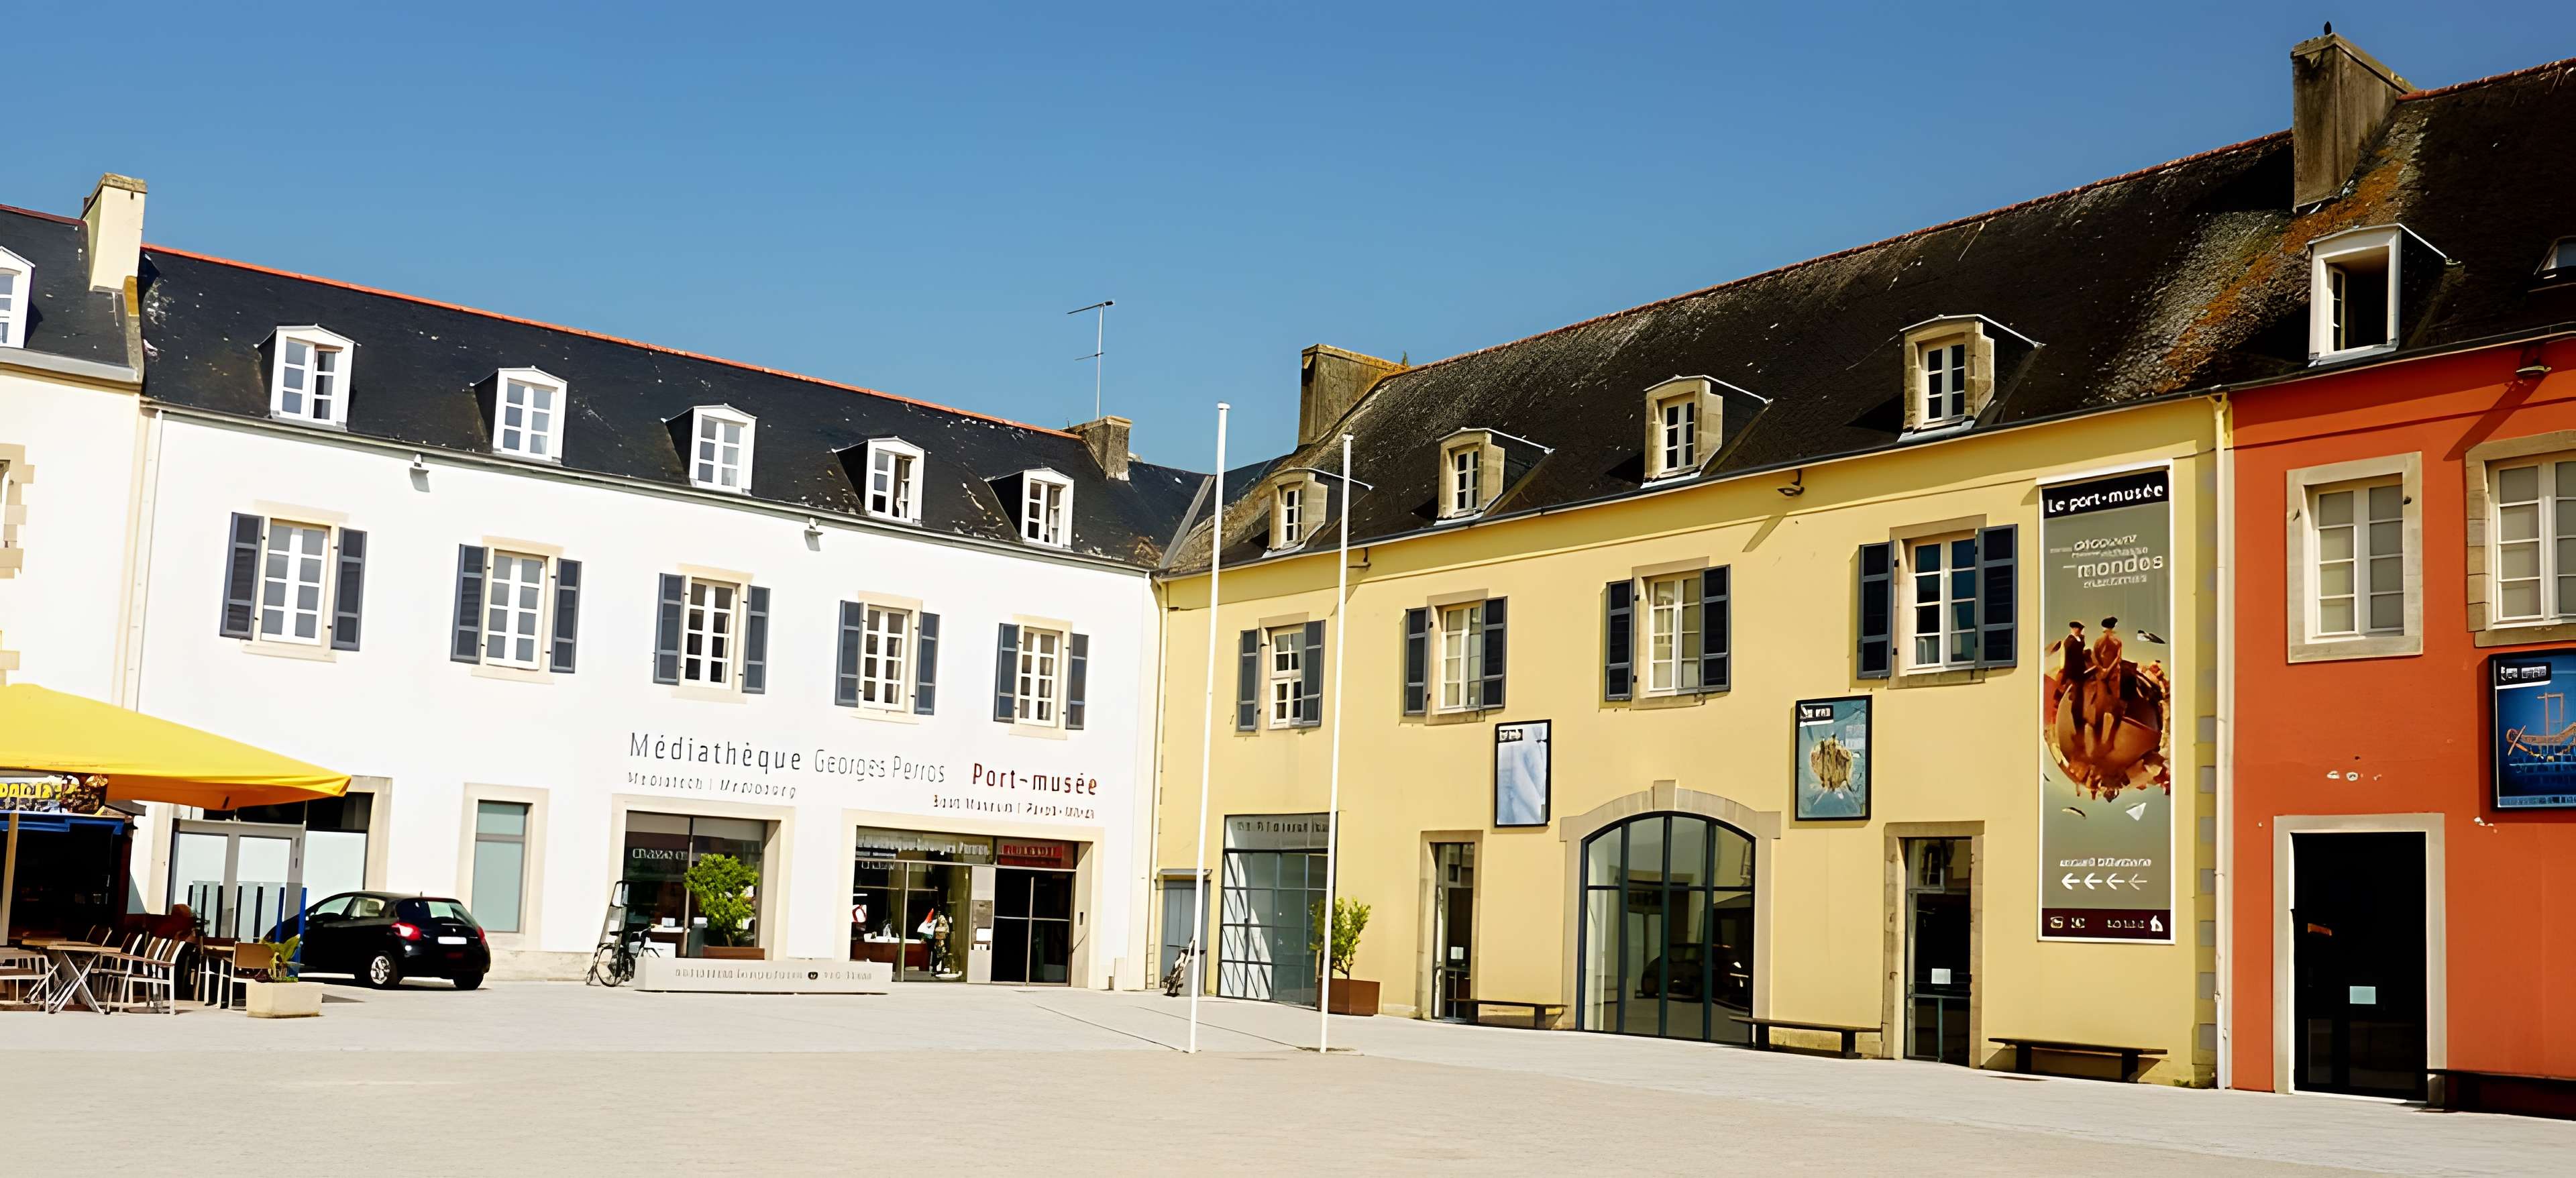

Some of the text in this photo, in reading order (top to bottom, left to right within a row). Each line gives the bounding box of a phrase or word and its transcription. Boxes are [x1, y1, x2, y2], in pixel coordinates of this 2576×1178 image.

[629, 731, 945, 784] Médiathèque Georges Perros
[972, 762, 1098, 796] Port-musée
